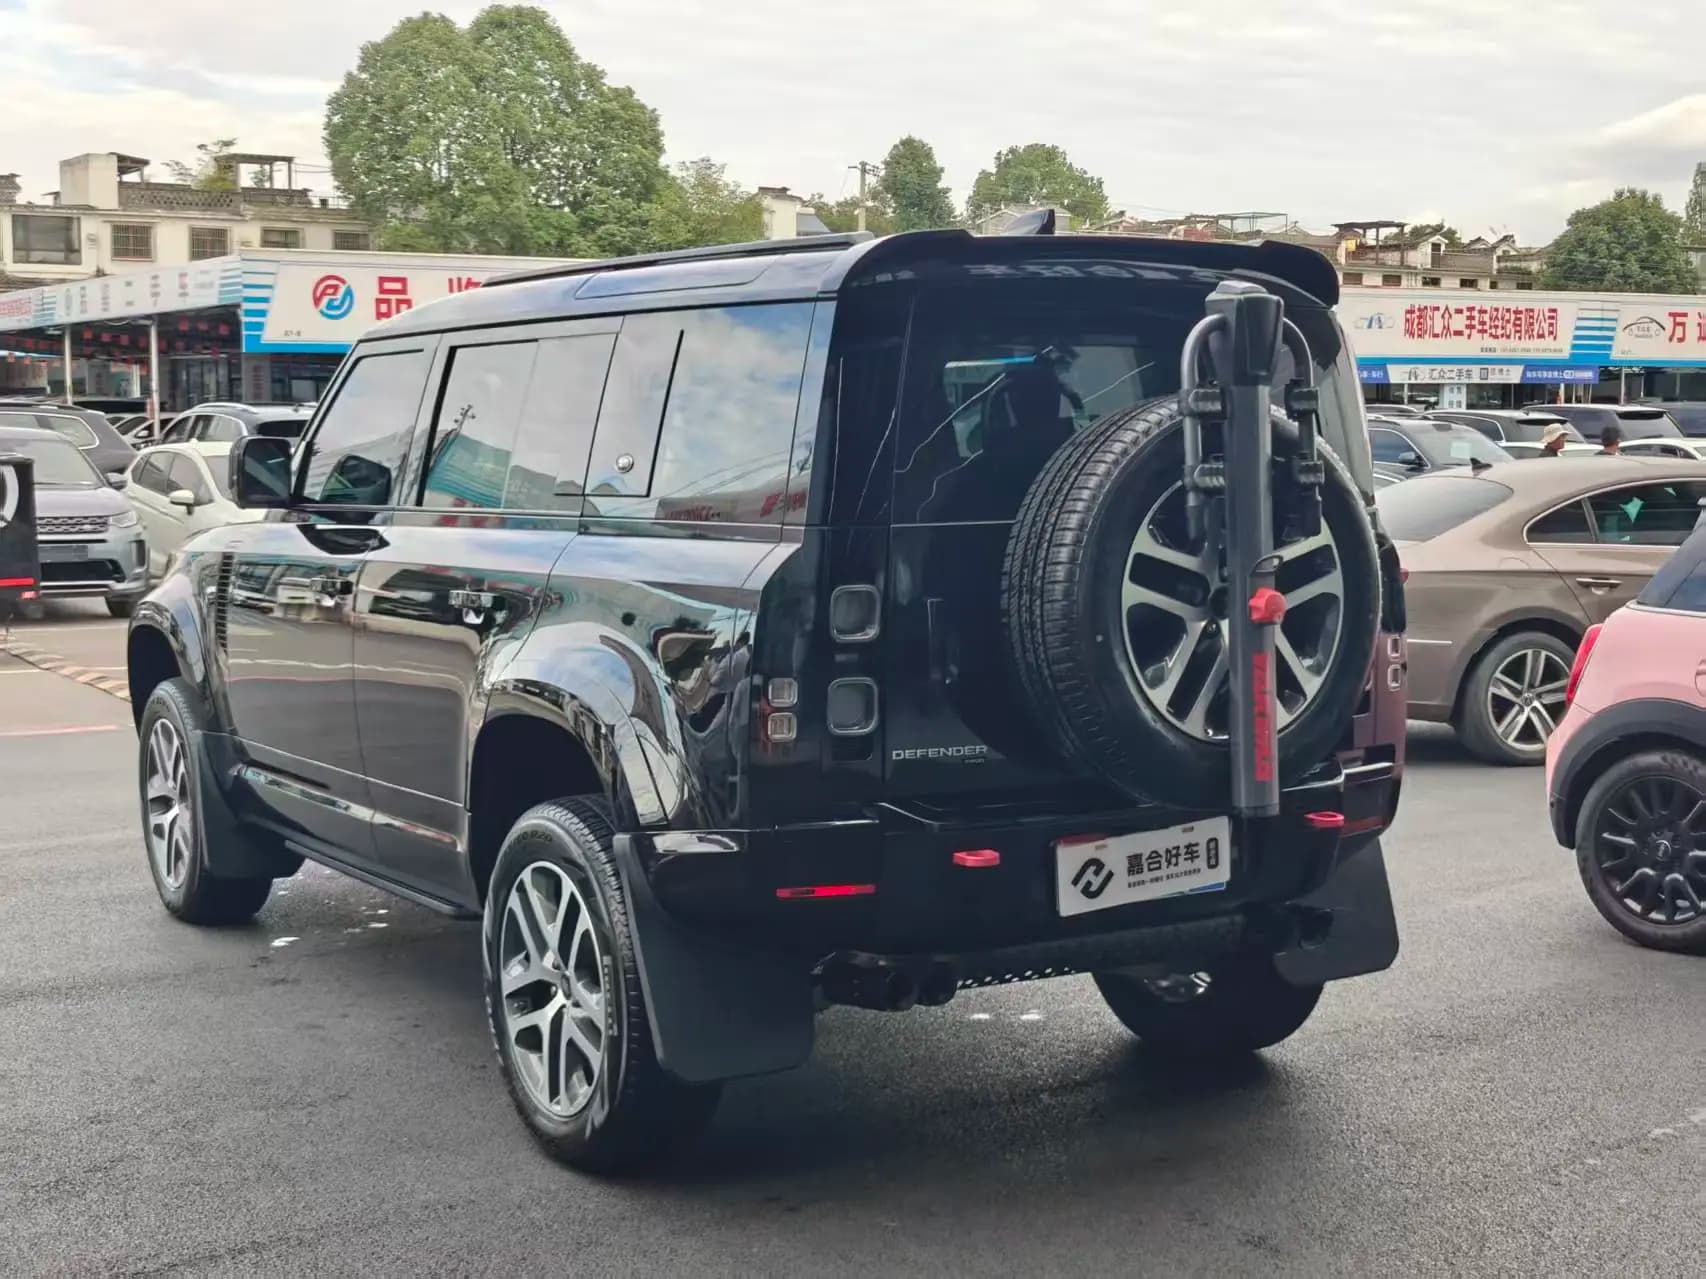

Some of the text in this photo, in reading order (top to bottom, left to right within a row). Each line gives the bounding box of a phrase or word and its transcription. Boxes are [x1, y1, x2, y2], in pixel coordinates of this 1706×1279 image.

[1404, 304, 1558, 341] 成都汇众二手车经纪有限公司
[1428, 367, 1473, 380] 汇众二手车
[892, 744, 988, 760] DEFENDER
[1126, 842, 1201, 877] 嘉合好车
